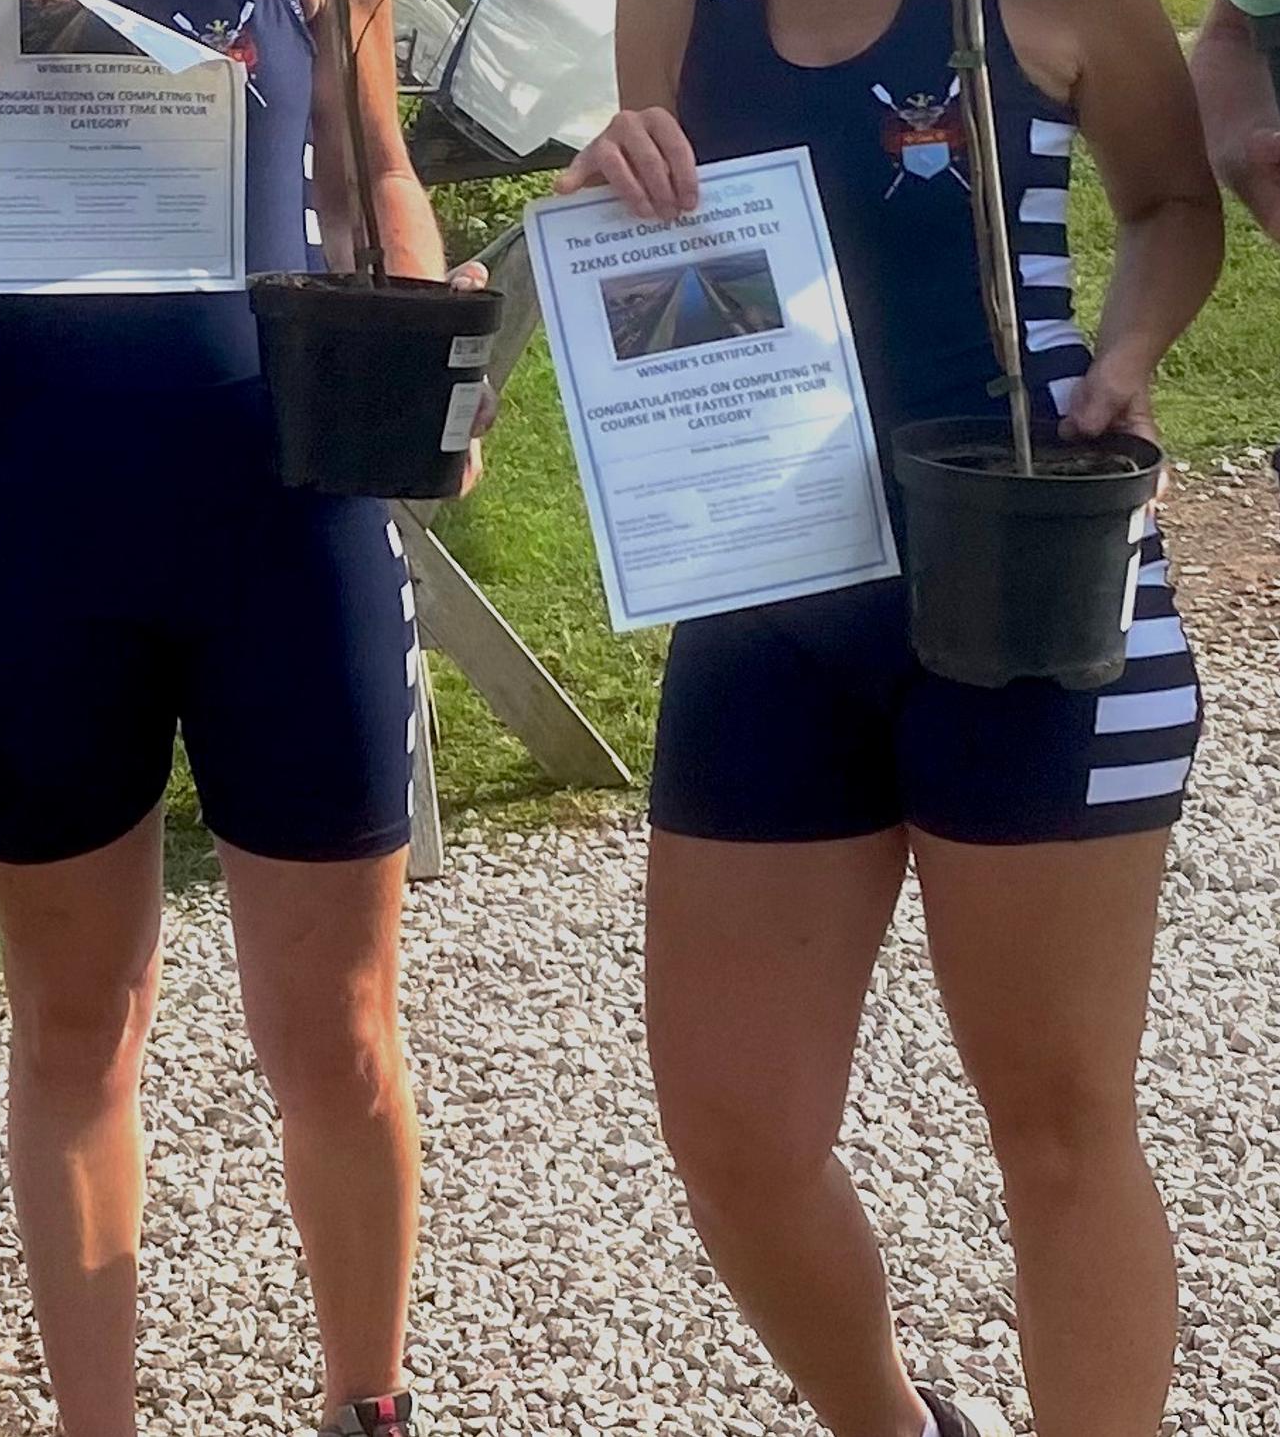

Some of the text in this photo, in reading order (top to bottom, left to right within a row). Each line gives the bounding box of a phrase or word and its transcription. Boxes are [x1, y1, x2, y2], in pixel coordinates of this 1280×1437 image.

[80, 105, 126, 115] FASTEST
[129, 105, 158, 115] TIME
[176, 105, 208, 115] YOUR
[97, 91, 115, 101] ON
[118, 91, 193, 102] COMPLETING
[195, 92, 217, 103] THE
[70, 118, 130, 130] CATEGORY
[566, 237, 592, 250] The
[594, 228, 634, 244] Great
[673, 206, 741, 228] Marathon
[743, 198, 774, 215] 2023
[570, 221, 781, 274] 22KMS COURSE DENVER TO ELY
[636, 342, 776, 378] WINNER'S CERTIFICATE
[587, 361, 833, 420] CONGRATULATIONS ON COMPLETING THE
[600, 378, 827, 433] COURSE IN THE FASTEST TIME IN YOUR
[688, 408, 752, 430] CATEGORY
